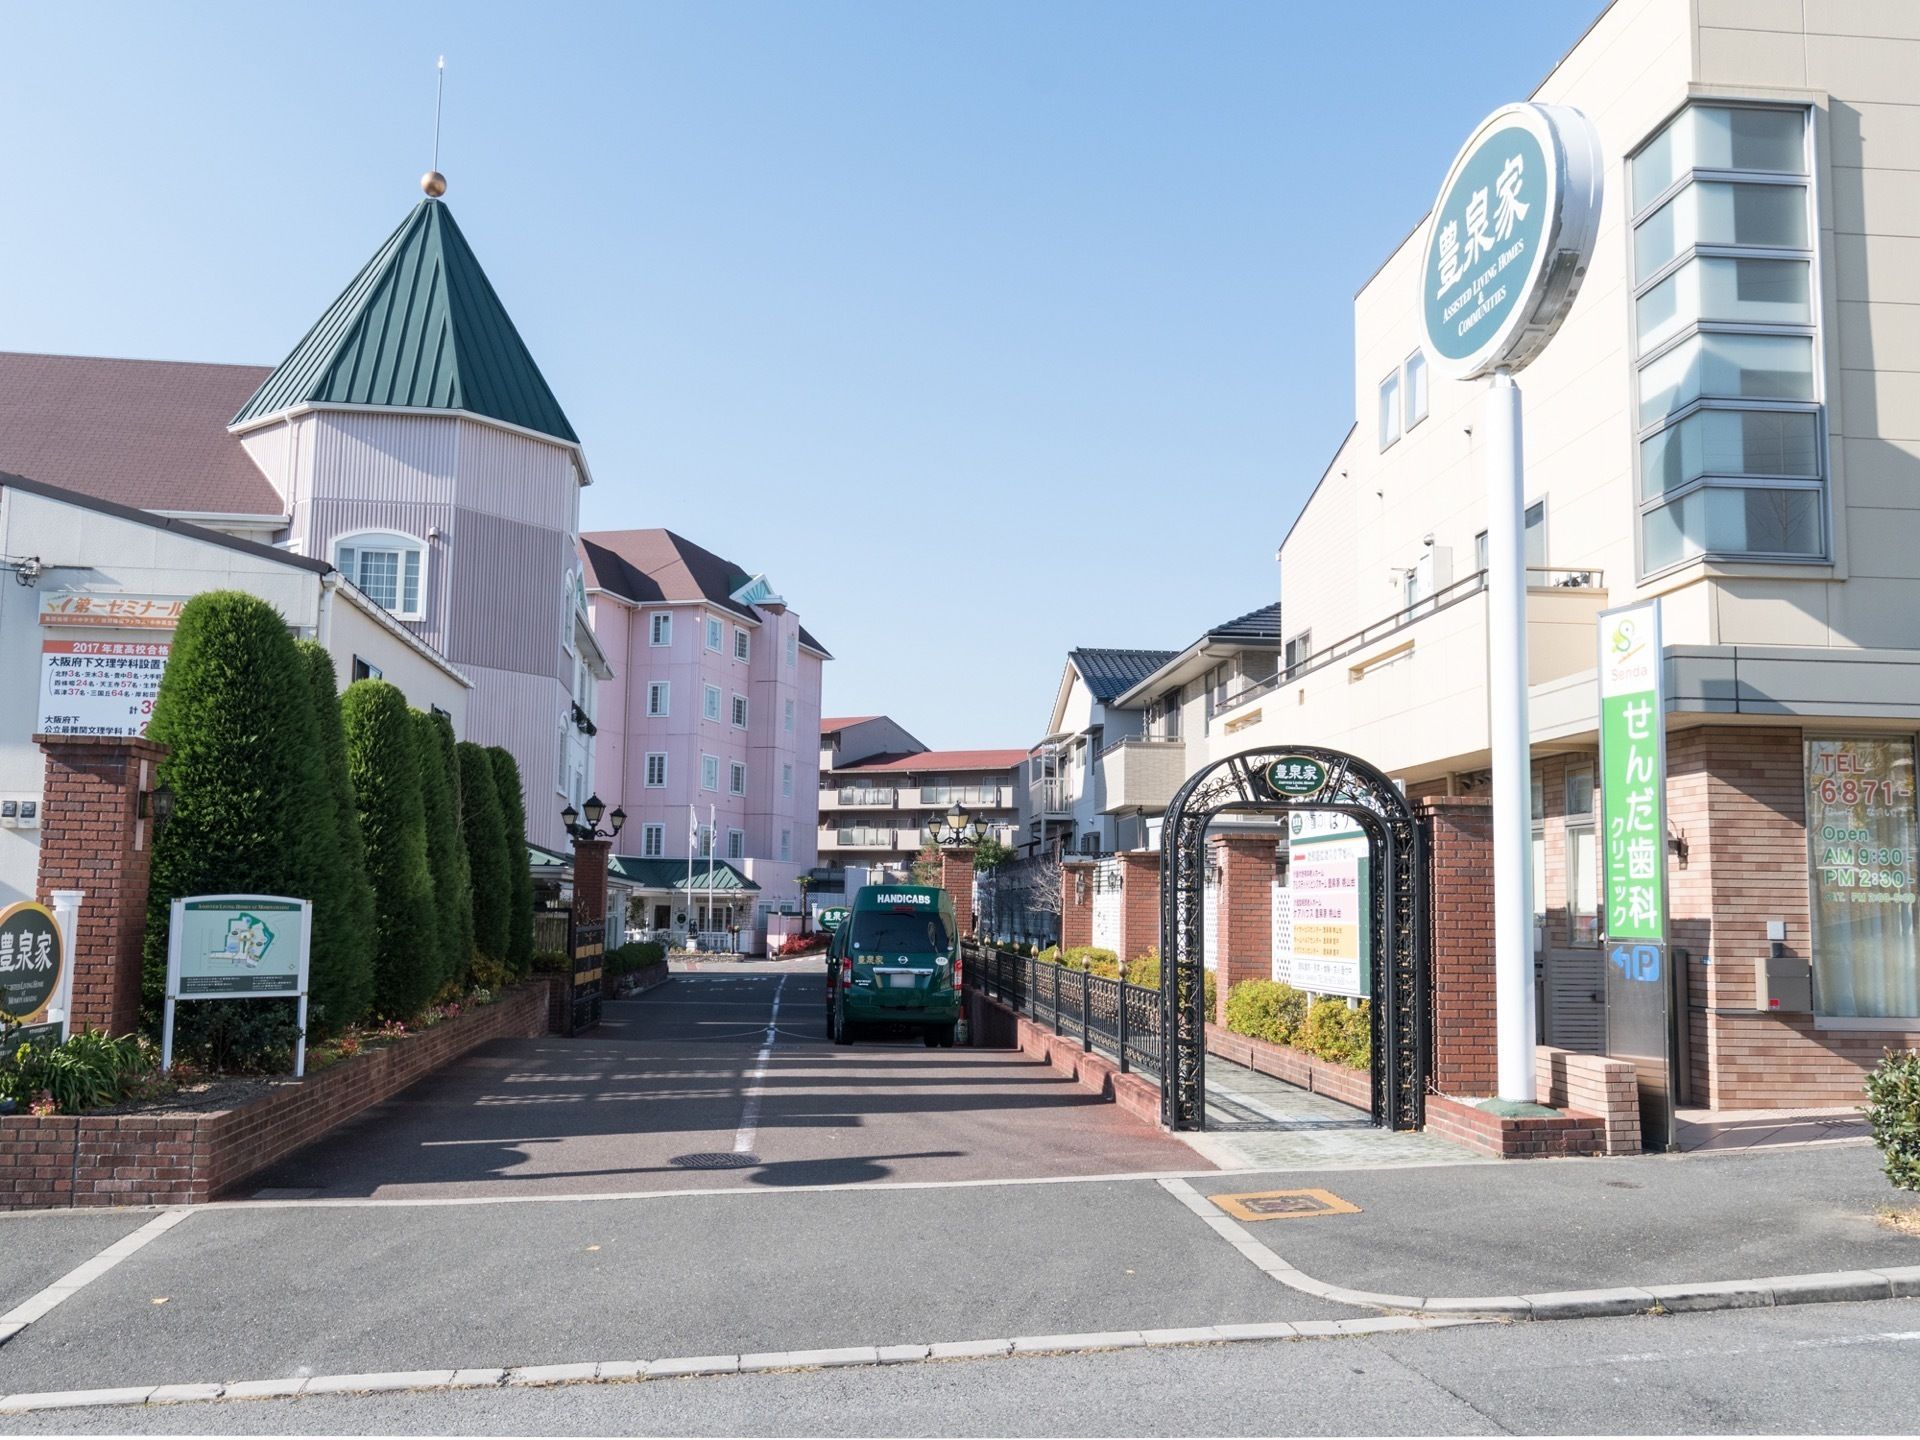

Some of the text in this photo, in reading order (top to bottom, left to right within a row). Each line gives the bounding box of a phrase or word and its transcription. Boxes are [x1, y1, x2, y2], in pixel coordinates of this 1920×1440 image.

[1437, 153, 1530, 300] 豊泉家
[1443, 240, 1525, 325] ASSISTED LIVING HOMES
[1478, 290, 1485, 306] &
[1458, 284, 1507, 337] COMMUNITIES
[1610, 666, 1648, 681] Senda
[1275, 764, 1318, 780] 豊泉家
[1819, 752, 1866, 774] TEL
[1622, 698, 1658, 929] せんだ歯科
[1822, 825, 1870, 844] Open
[1823, 847, 1855, 865] AM
[1611, 816, 1627, 928] クリニック
[1824, 869, 1856, 887] PM
[877, 894, 931, 905] HANDICABS
[0, 929, 52, 973] 豊泉家
